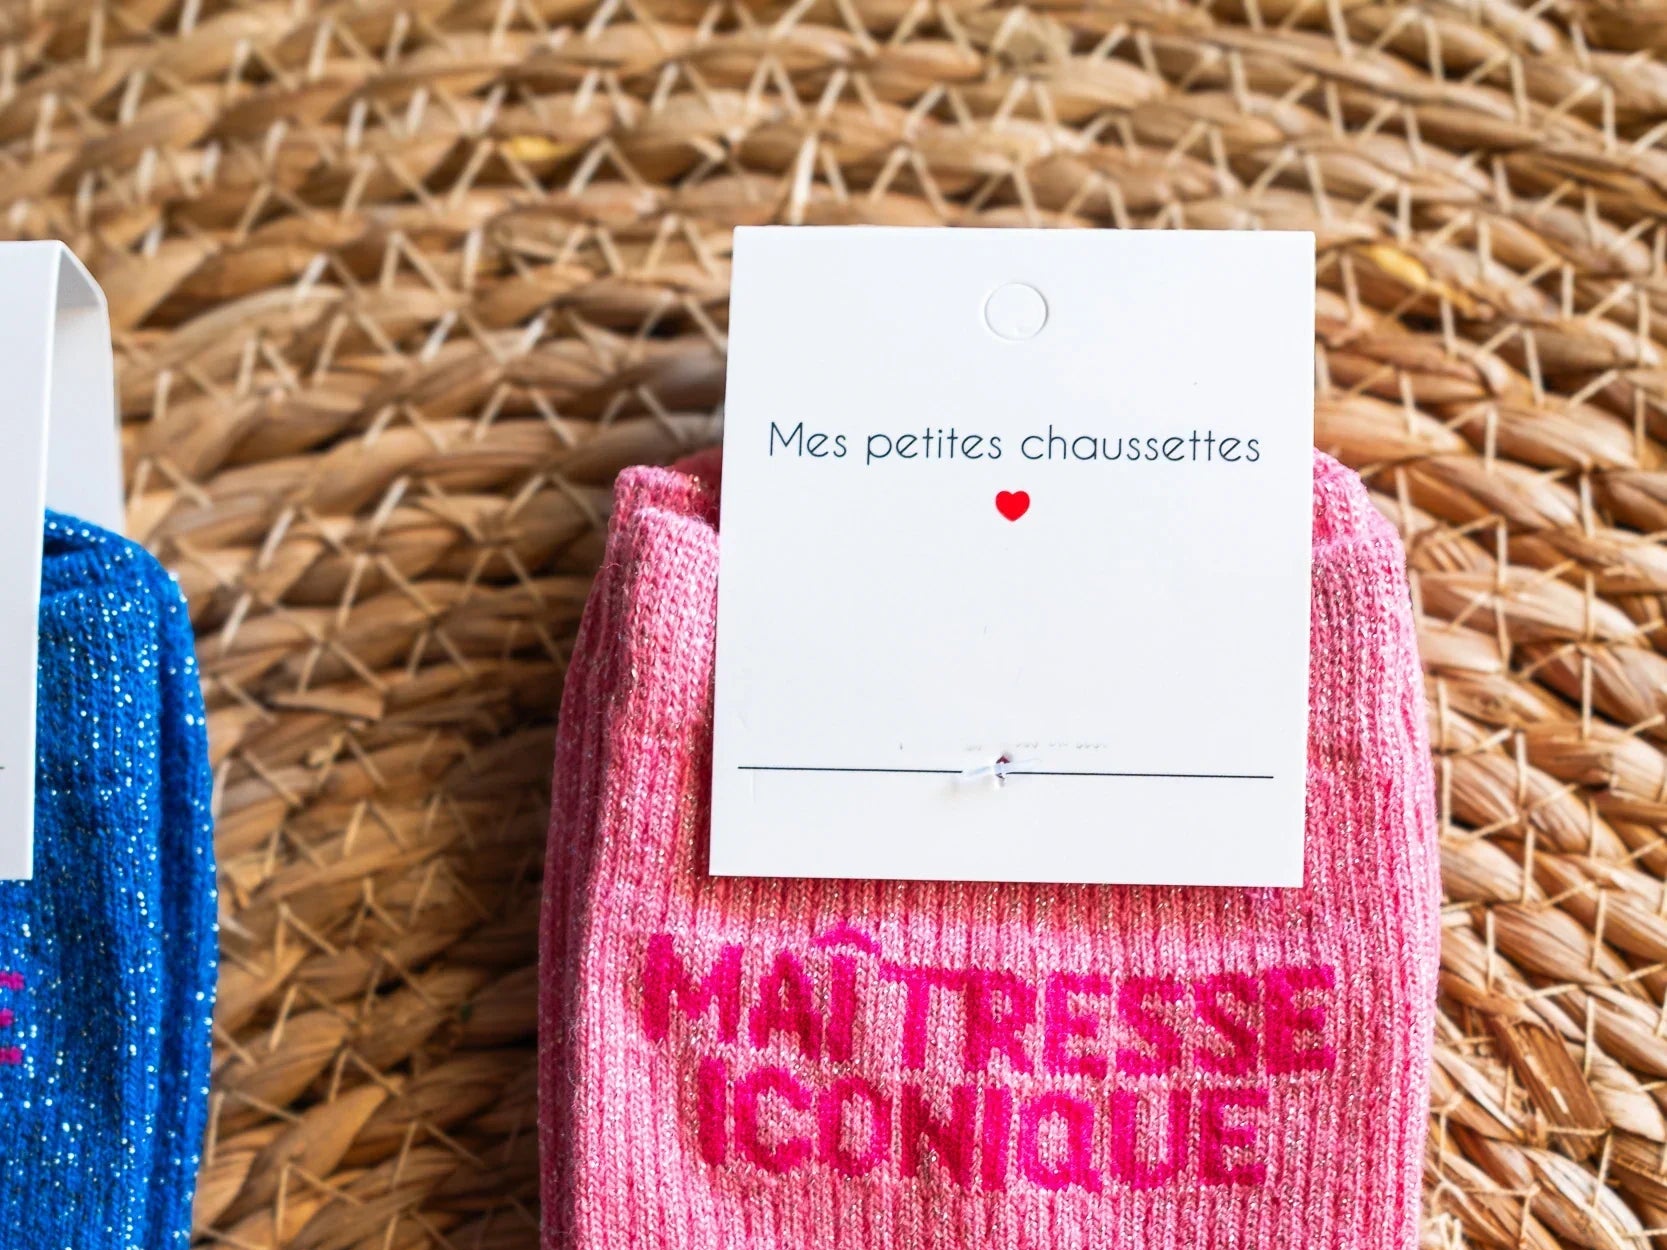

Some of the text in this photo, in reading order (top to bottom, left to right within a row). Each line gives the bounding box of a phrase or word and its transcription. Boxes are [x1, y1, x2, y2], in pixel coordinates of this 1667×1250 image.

[769, 421, 1262, 466] Mes petites chaussettes
[640, 922, 1335, 1077] MAÎTRESSE
[700, 1056, 1269, 1193] ICONIQUE
